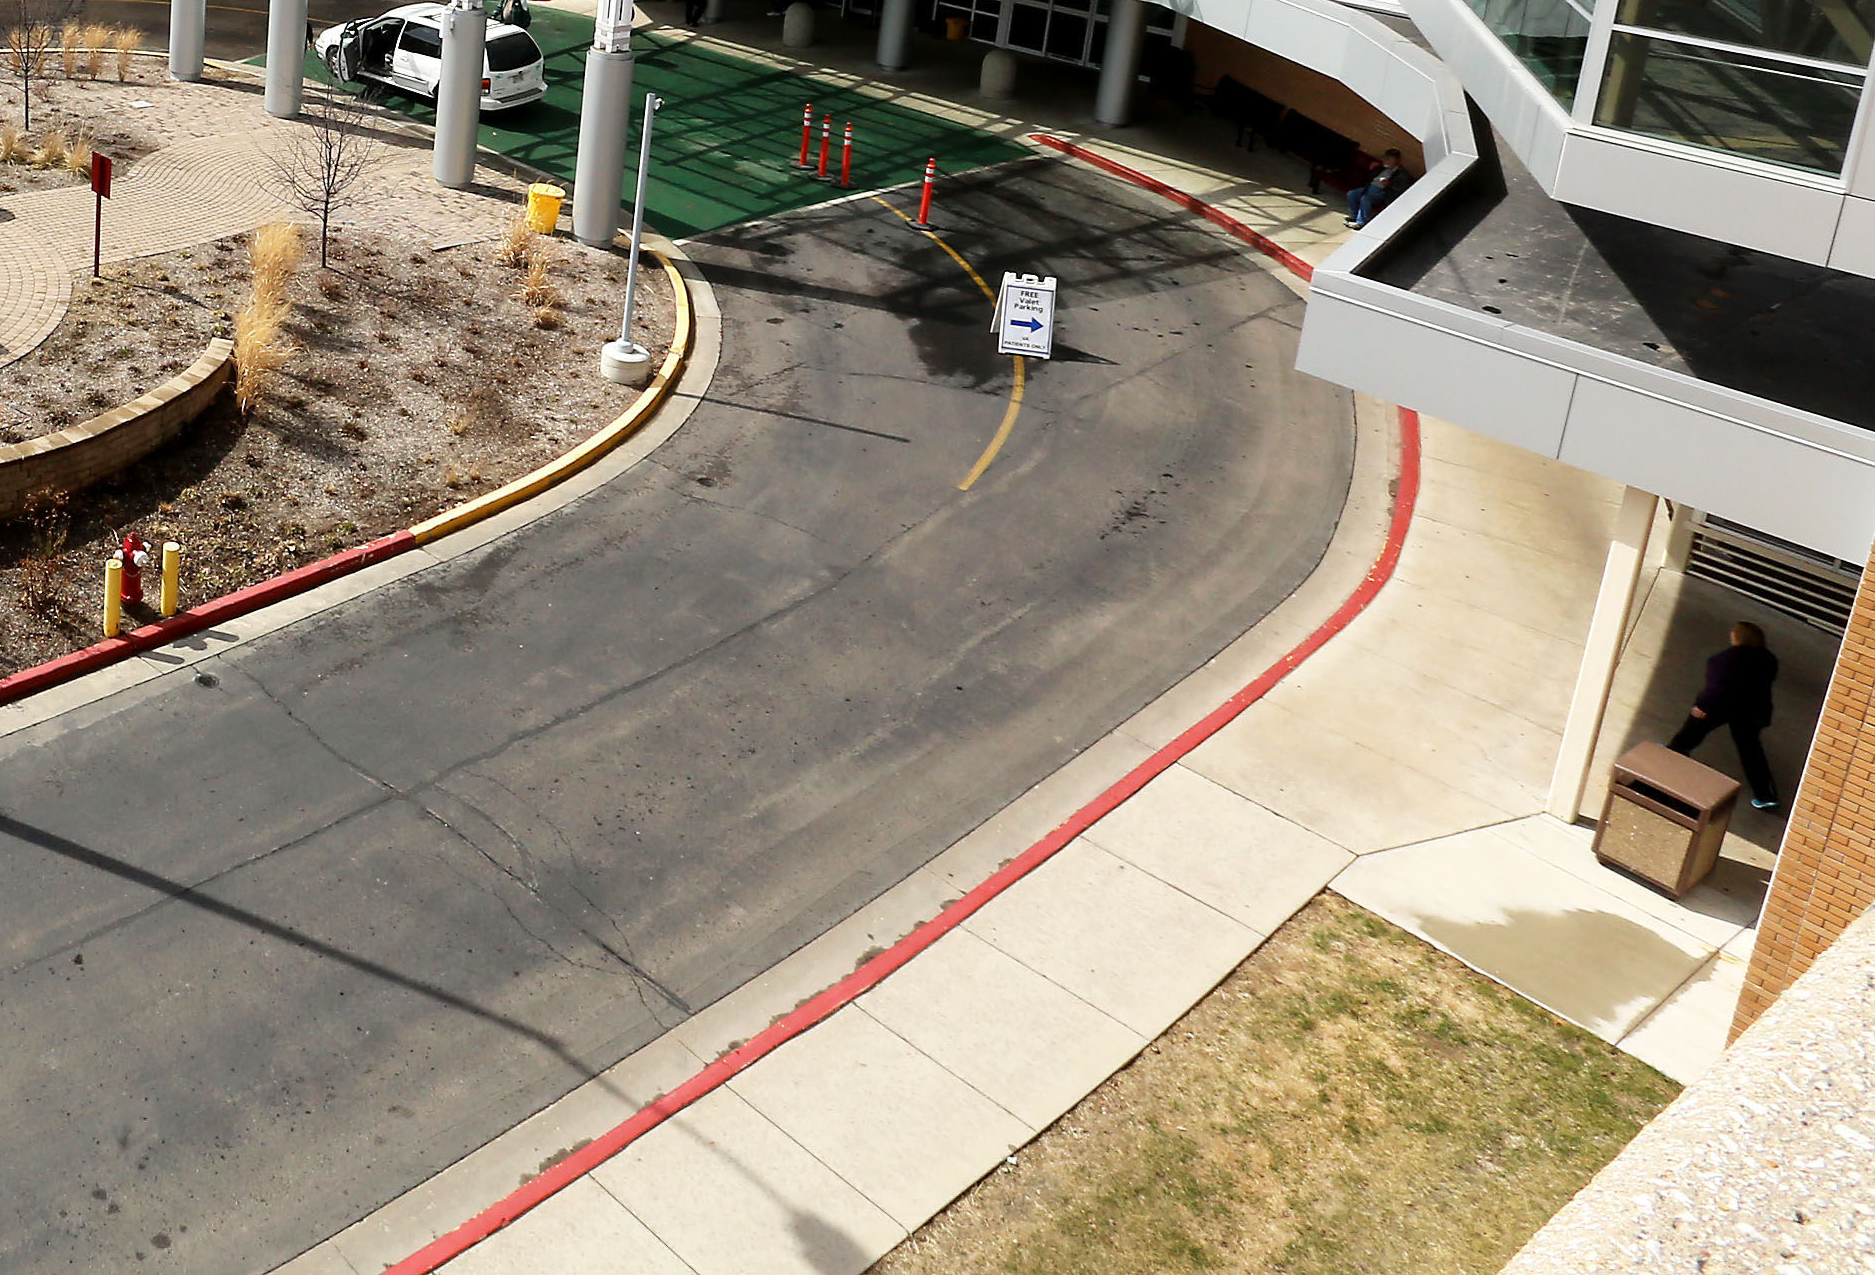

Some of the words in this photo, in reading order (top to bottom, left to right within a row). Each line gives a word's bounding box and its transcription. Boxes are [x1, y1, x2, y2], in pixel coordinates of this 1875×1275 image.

[1020, 290, 1038, 299] FREE
[1019, 297, 1040, 306] Valet
[1013, 303, 1044, 314] Parking
[1004, 340, 1030, 348] PATIENTS
